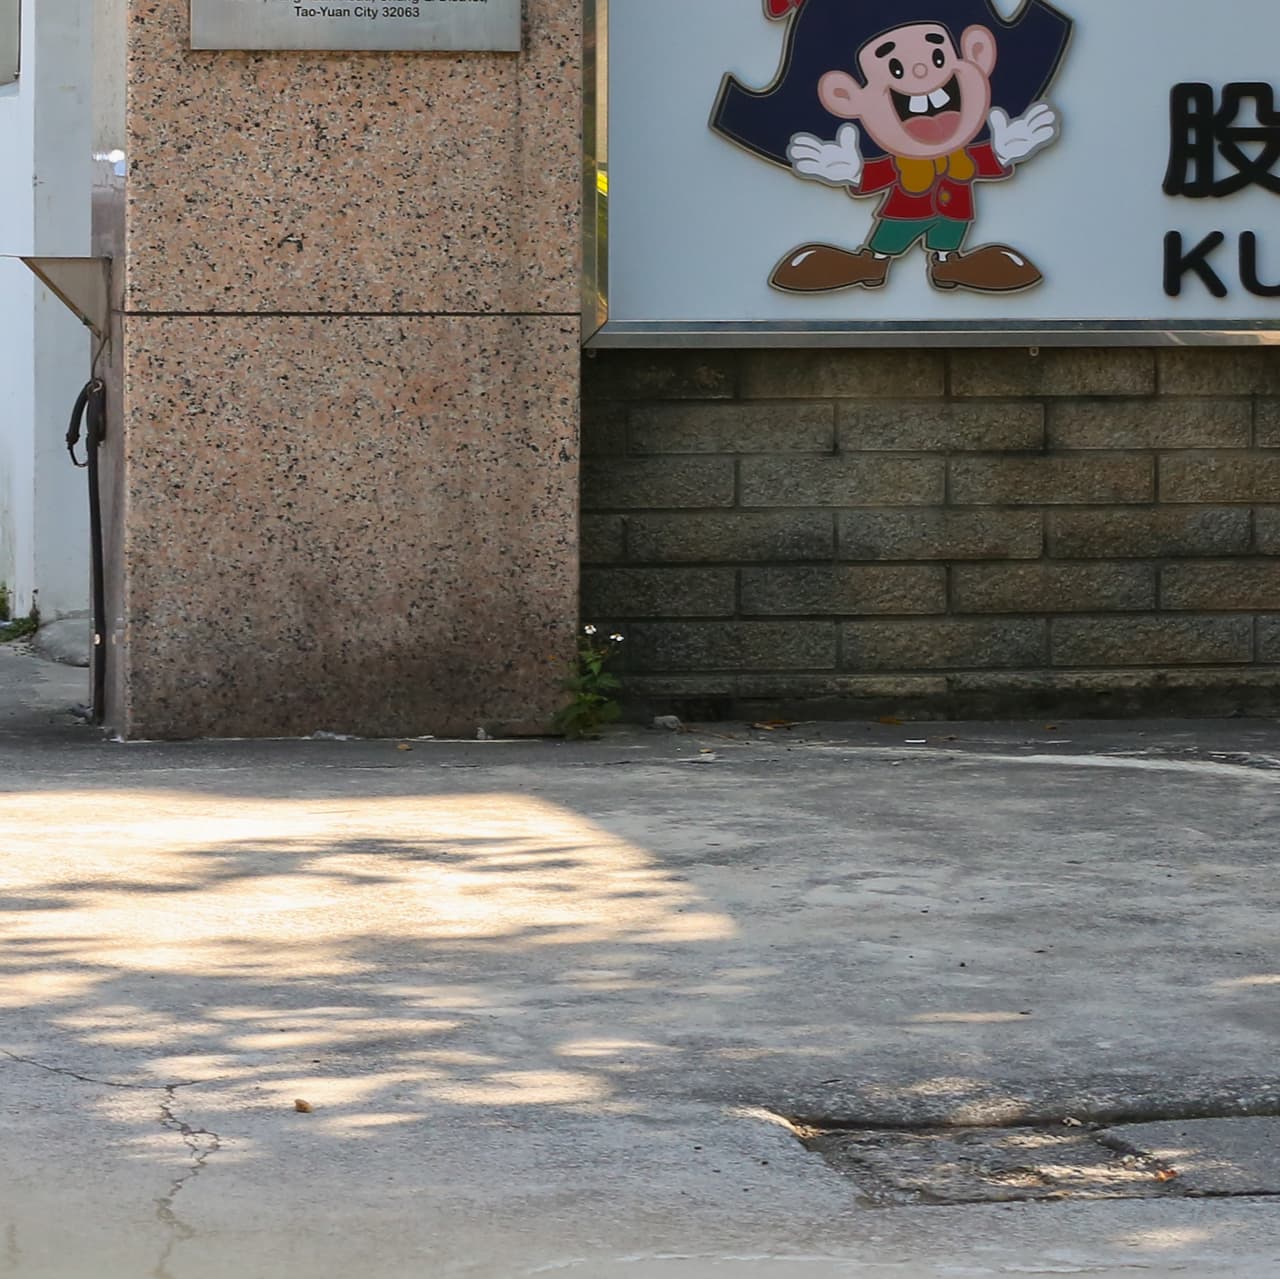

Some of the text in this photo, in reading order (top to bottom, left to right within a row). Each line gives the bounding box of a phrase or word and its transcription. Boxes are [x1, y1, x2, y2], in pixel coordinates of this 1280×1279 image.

[294, 6, 420, 20] Tao-Yuan City 32063
